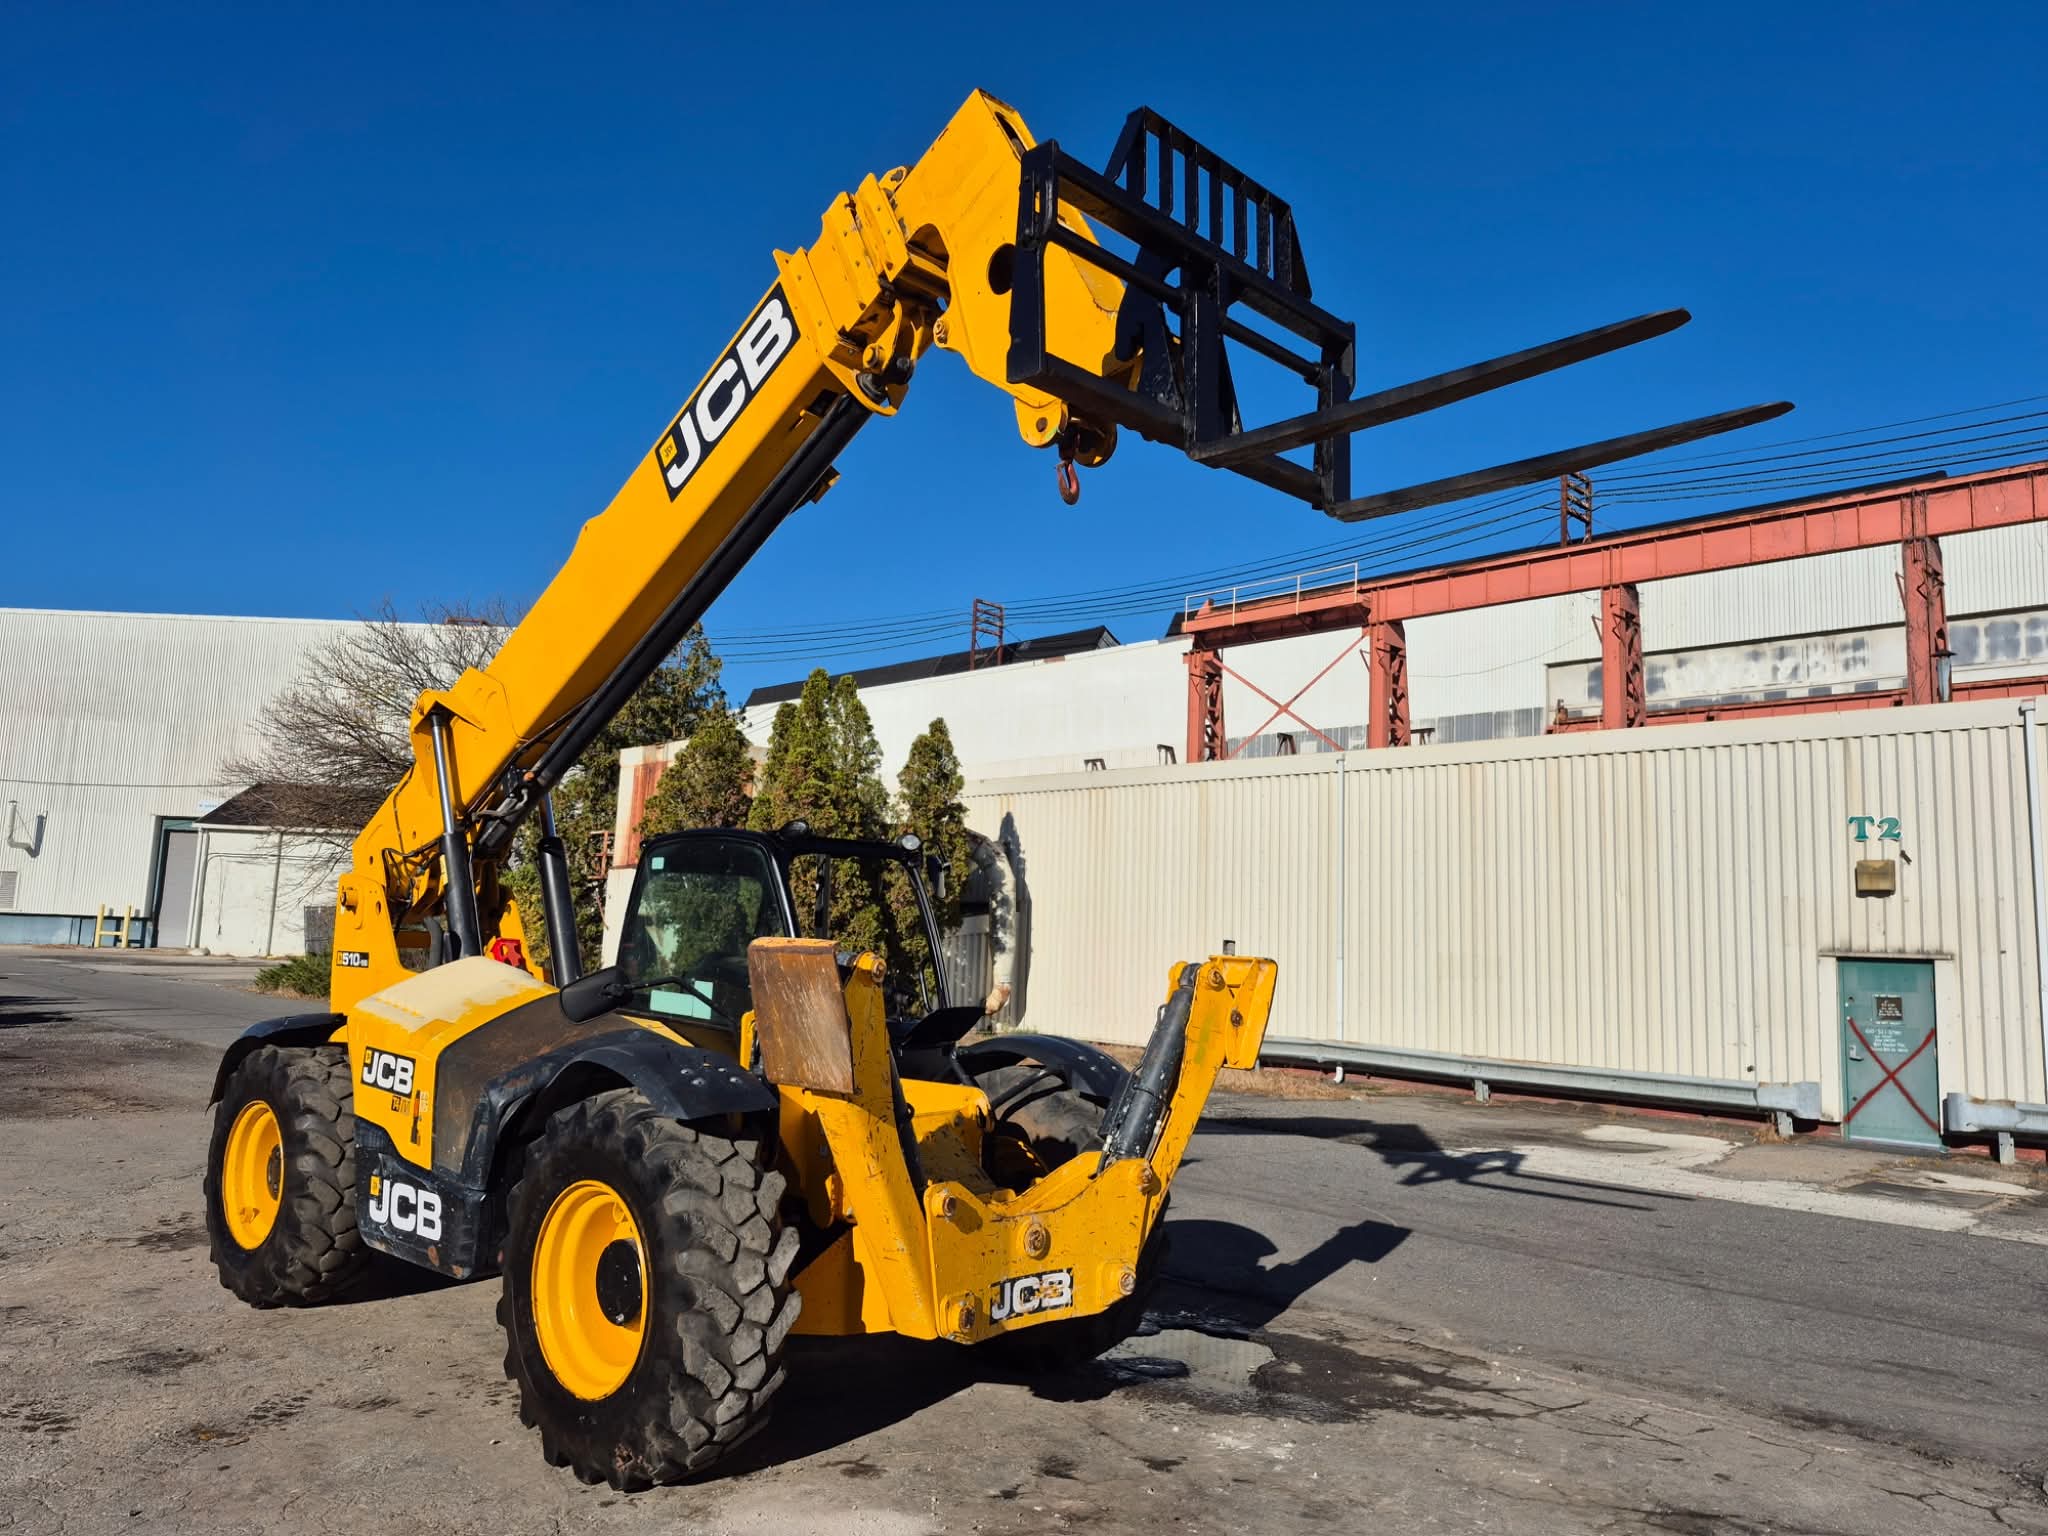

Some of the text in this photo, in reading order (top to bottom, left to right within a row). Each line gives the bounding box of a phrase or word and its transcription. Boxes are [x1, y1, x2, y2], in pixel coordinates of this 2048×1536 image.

[666, 298, 793, 489] JCB
[1848, 815, 1902, 840] T2
[363, 1051, 414, 1095] JCB
[369, 1179, 442, 1241] JCB
[991, 1272, 1072, 1320] JCB
